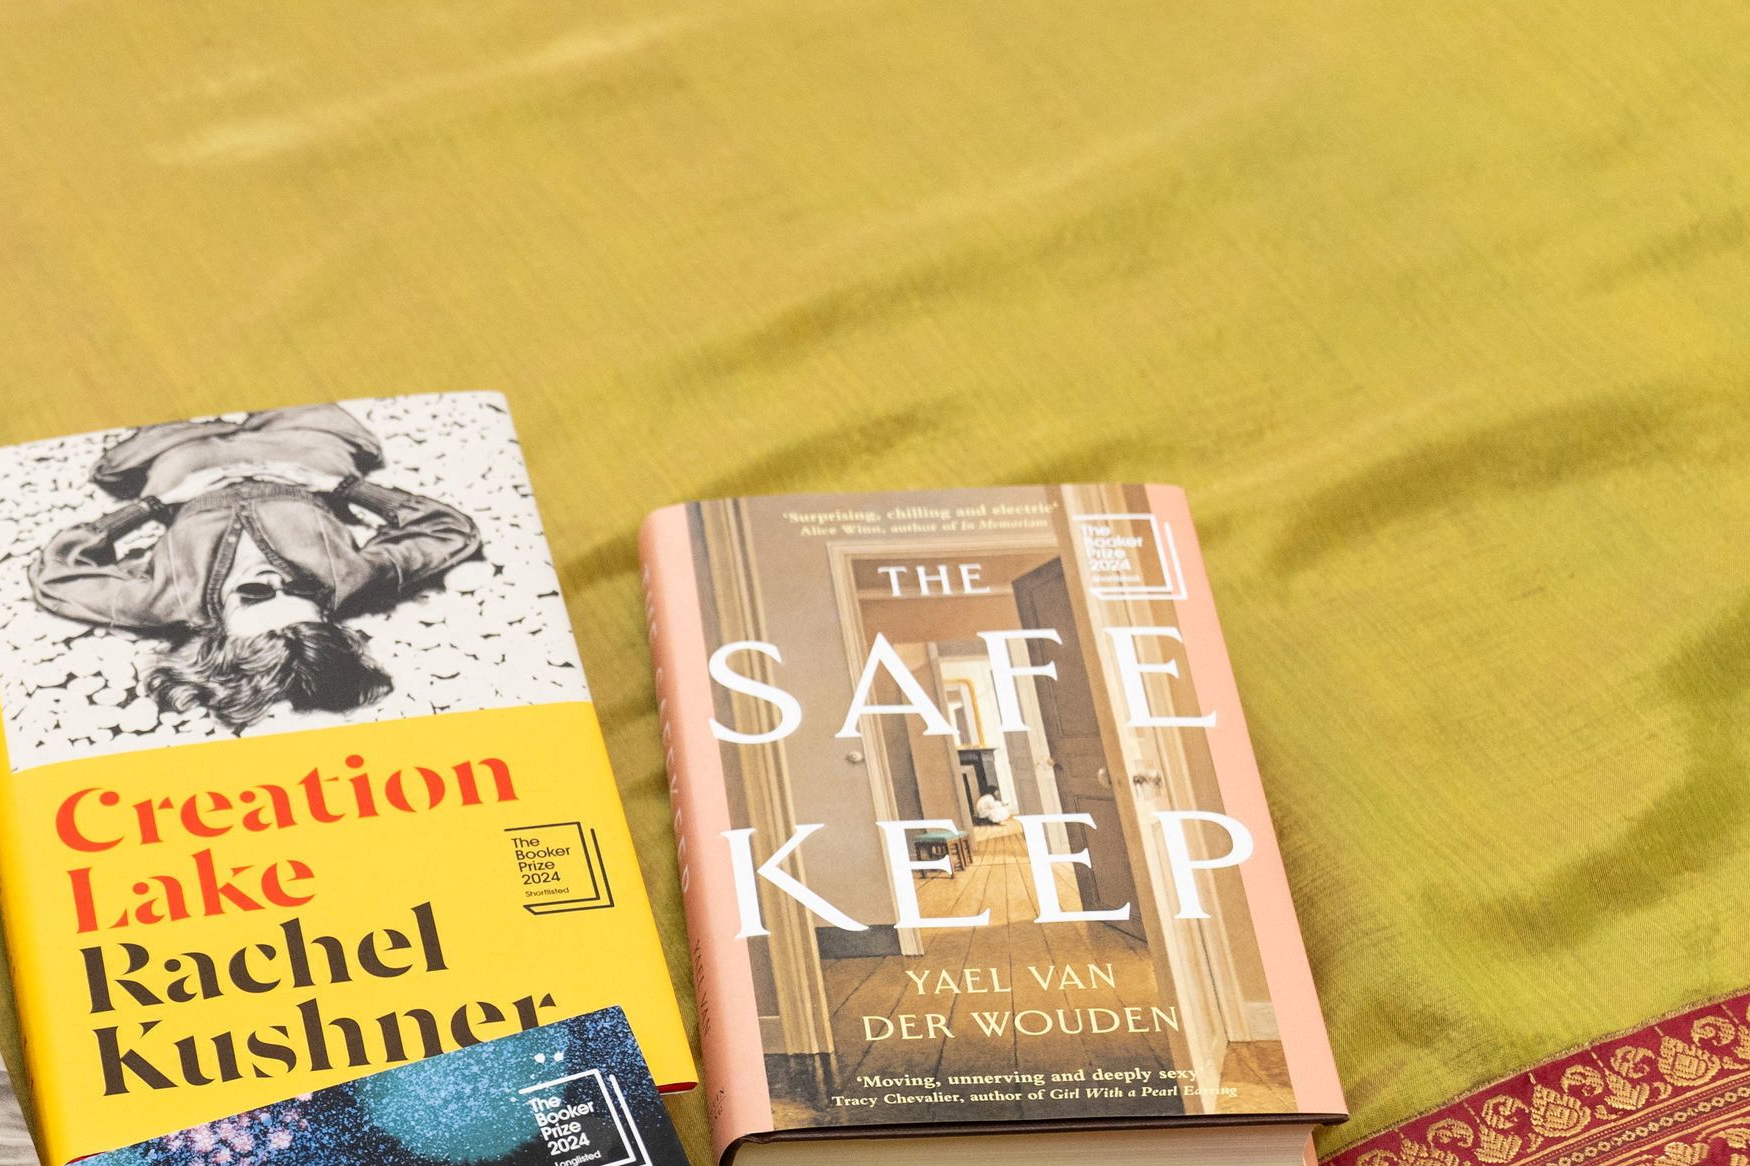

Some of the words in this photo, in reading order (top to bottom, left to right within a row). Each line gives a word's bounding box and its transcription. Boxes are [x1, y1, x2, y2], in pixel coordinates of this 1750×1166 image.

[955, 503, 987, 517] and
[877, 562, 990, 597] THE
[707, 626, 1218, 744] SAFE
[55, 754, 520, 853] Creation
[511, 838, 540, 848] The
[515, 847, 570, 861] Booker
[518, 860, 555, 872] Prize
[522, 871, 561, 885] 2024
[720, 811, 1254, 939] KEEP
[66, 848, 316, 934] Lake
[525, 887, 570, 897] Shortlisted
[79, 901, 449, 1014] Rachel
[906, 967, 1012, 996] YAEL
[1028, 963, 1116, 991] VAN
[862, 1013, 955, 1042] DER
[970, 1006, 1181, 1038] WOUDEN
[92, 993, 557, 1097] Kushner
[856, 1073, 941, 1090] ‘Moving,
[948, 1071, 1046, 1087] unnerving
[1051, 1069, 1086, 1083] and
[1092, 1067, 1152, 1084] deeply
[528, 1096, 561, 1113] The
[832, 1094, 878, 1108] Tracy
[883, 1091, 965, 1106] Chevalier,
[970, 1089, 1024, 1103] author
[1028, 1088, 1047, 1101] of
[1050, 1087, 1080, 1101] Girl
[1085, 1086, 1124, 1099] With
[1127, 1089, 1136, 1098] a
[1141, 1085, 1178, 1097] Pearl
[535, 1101, 595, 1127] Booker
[540, 1121, 582, 1141] Prize
[548, 1132, 591, 1156] 2024
